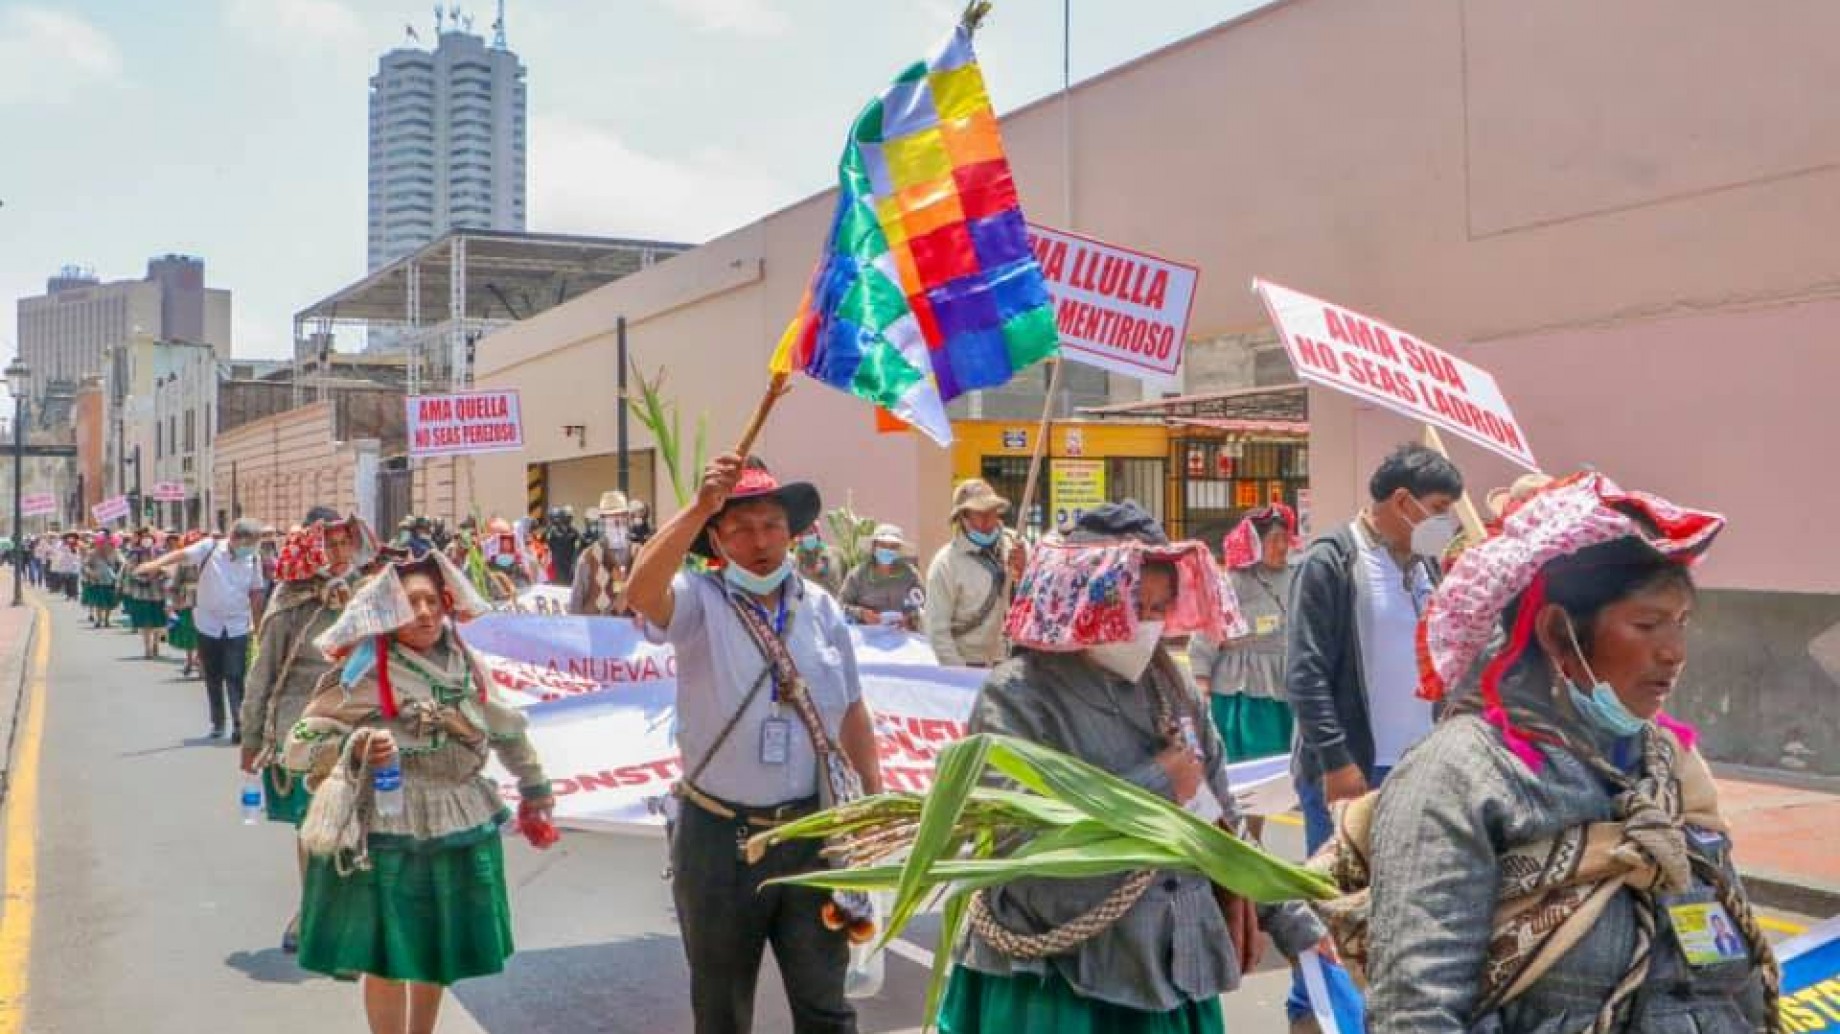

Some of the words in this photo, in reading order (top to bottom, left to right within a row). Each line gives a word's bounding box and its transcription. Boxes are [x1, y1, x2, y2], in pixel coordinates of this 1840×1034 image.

[1028, 233, 1068, 282] MA
[1069, 247, 1169, 310] LLULLA
[1057, 297, 1176, 361] MENTIROSO
[1323, 306, 1401, 365] AMA
[1399, 335, 1468, 393] SUA
[419, 399, 452, 422] AMA
[456, 394, 508, 422] QUELLA
[1294, 333, 1341, 375] NO
[1343, 351, 1419, 404] SEAS
[1417, 379, 1526, 453] LADRON
[415, 428, 430, 448] NO
[432, 426, 461, 447] SEAS
[463, 423, 517, 444] PEREZOSO
[568, 655, 661, 683] NUEVA
